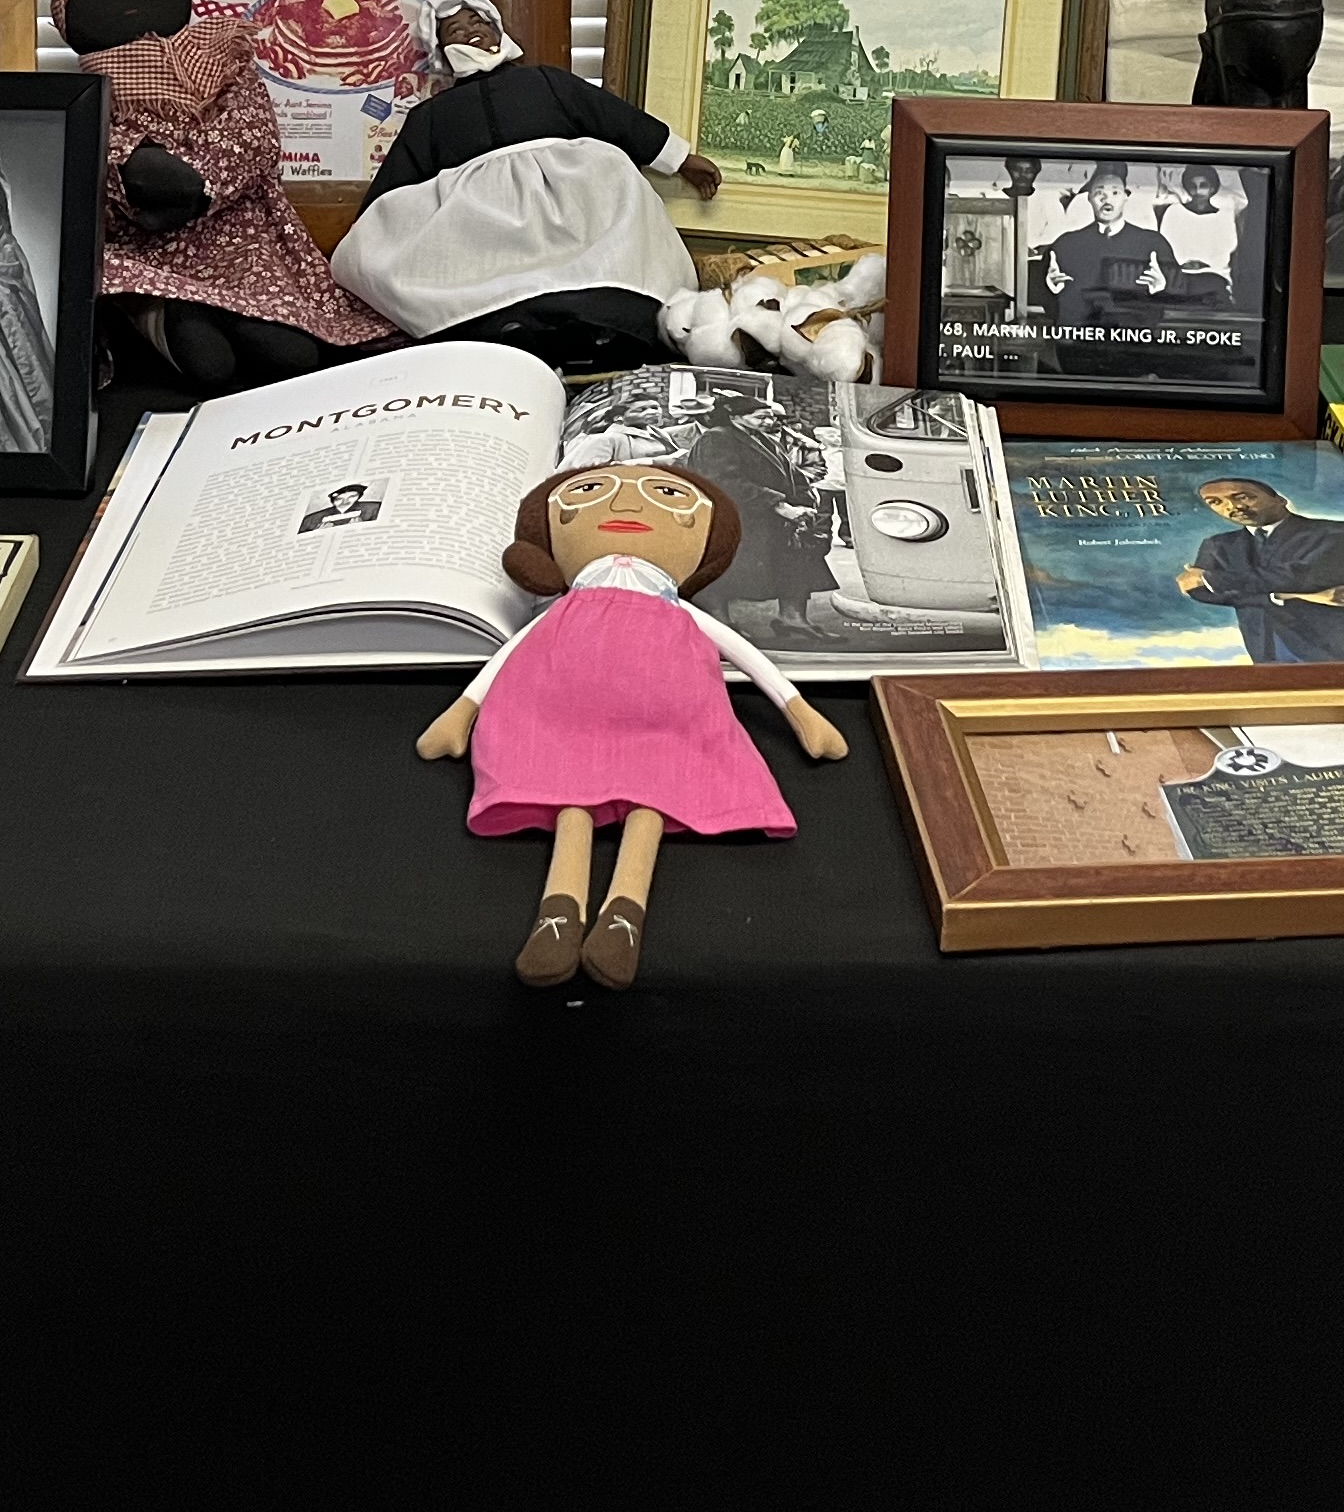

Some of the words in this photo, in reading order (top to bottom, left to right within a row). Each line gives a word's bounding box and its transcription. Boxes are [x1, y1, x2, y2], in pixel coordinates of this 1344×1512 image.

[290, 164, 333, 178] Waffles
[972, 323, 1038, 339] MARTIN
[1042, 325, 1106, 342] LUTHER
[1109, 327, 1153, 344] KING
[1157, 329, 1182, 345] JR.
[1186, 330, 1243, 347] SPOKE
[952, 345, 995, 360] PAUL
[229, 393, 532, 451] MONTGOMERY
[330, 412, 418, 434] ALABAMA
[1115, 452, 1184, 461] CORETTA
[1186, 452, 1234, 460] SCOTT
[1238, 452, 1277, 461] KING
[1025, 474, 1159, 490] MARTIN
[1031, 489, 1168, 504] LUTHER
[1036, 503, 1131, 519] KING,
[1240, 774, 1289, 788] VISITS
